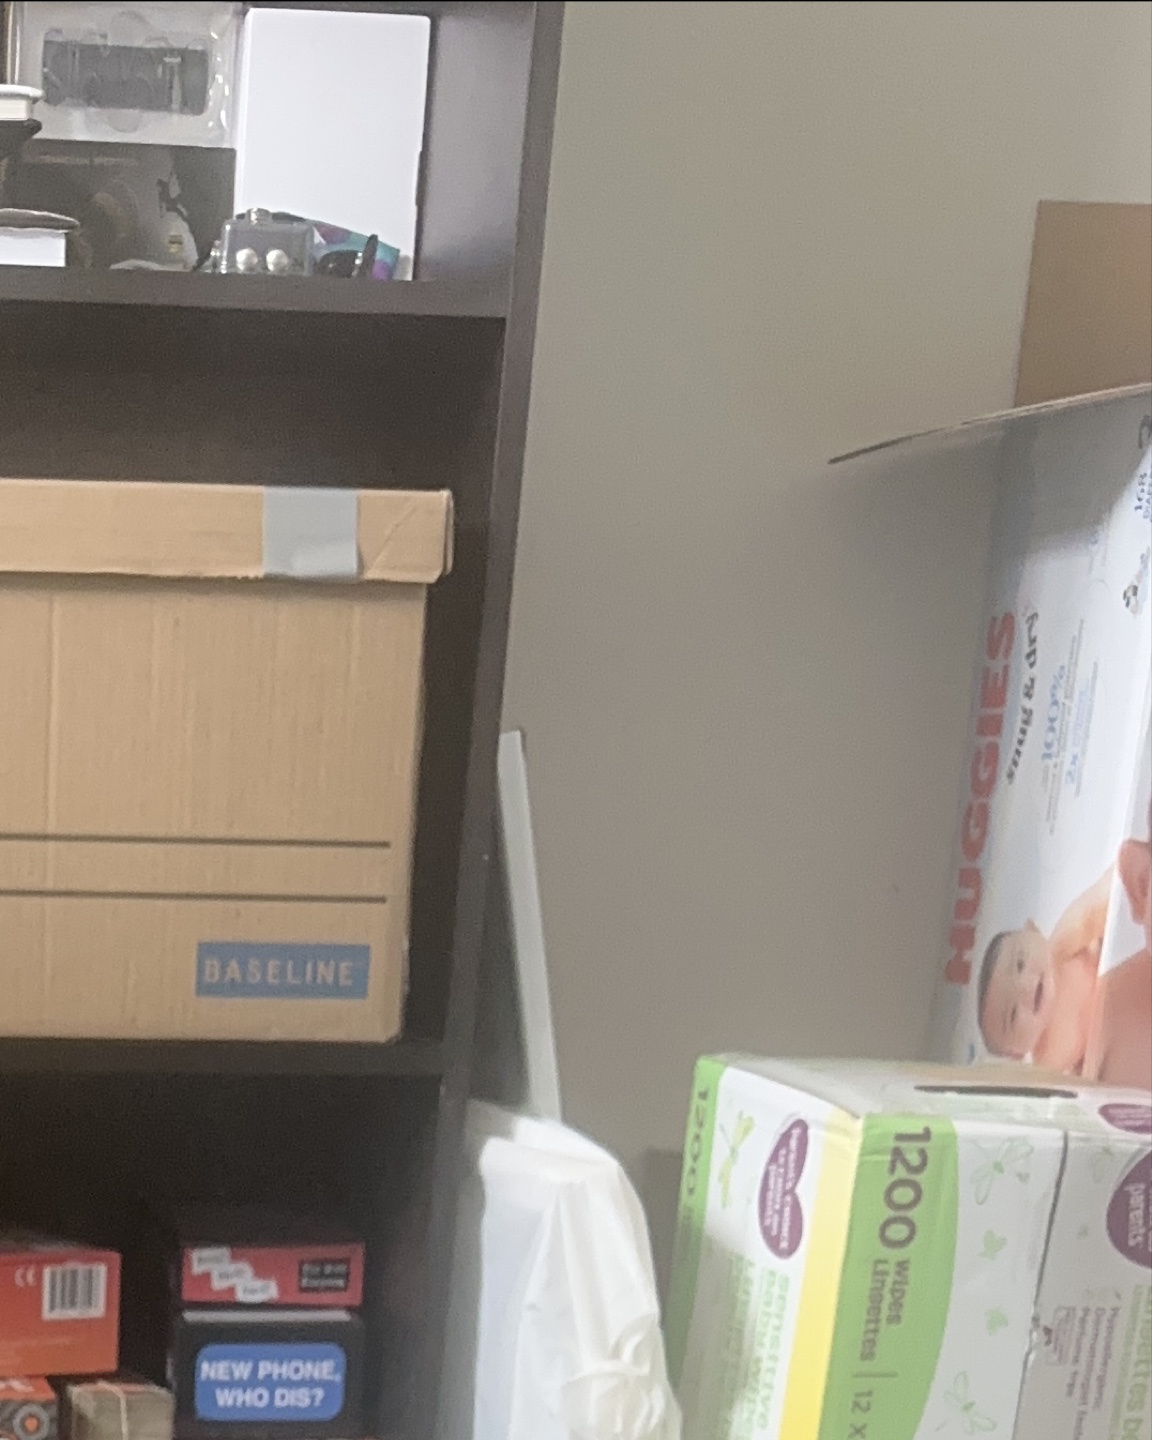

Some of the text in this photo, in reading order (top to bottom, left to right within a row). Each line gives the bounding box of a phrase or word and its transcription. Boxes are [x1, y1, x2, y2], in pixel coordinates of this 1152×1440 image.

[1006, 611, 1039, 786] snug & dry
[945, 611, 1016, 986] HUGGIES
[204, 957, 354, 987] BASELINE
[685, 1088, 709, 1197] 1200
[878, 1126, 931, 1250] 1200
[200, 1358, 342, 1383] NEW PHONE,
[214, 1386, 325, 1409] WHO DIS?
[851, 1389, 873, 1414] 12
